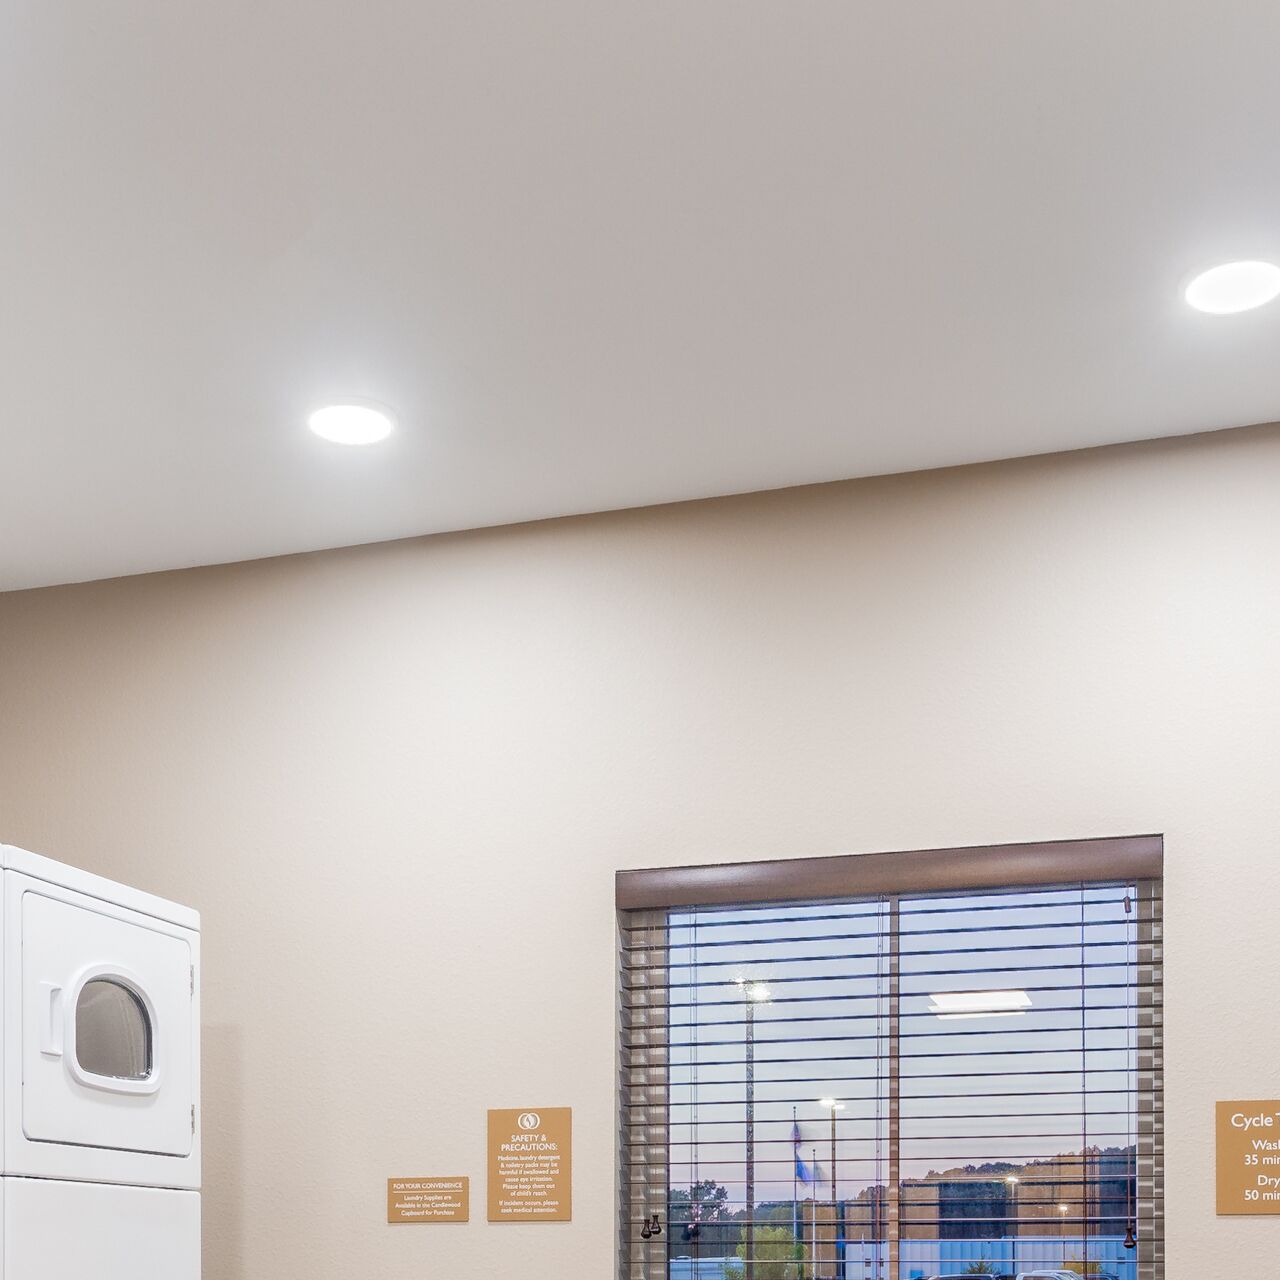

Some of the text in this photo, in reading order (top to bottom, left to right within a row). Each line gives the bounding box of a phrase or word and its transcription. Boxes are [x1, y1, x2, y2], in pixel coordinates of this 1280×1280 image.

[1231, 1113, 1273, 1131] Cycle
[511, 1134, 539, 1142] SAFETY
[501, 1143, 558, 1151] PRECAUTIONS:
[1244, 1154, 1258, 1165] 35
[1244, 1189, 1258, 1201] 50
